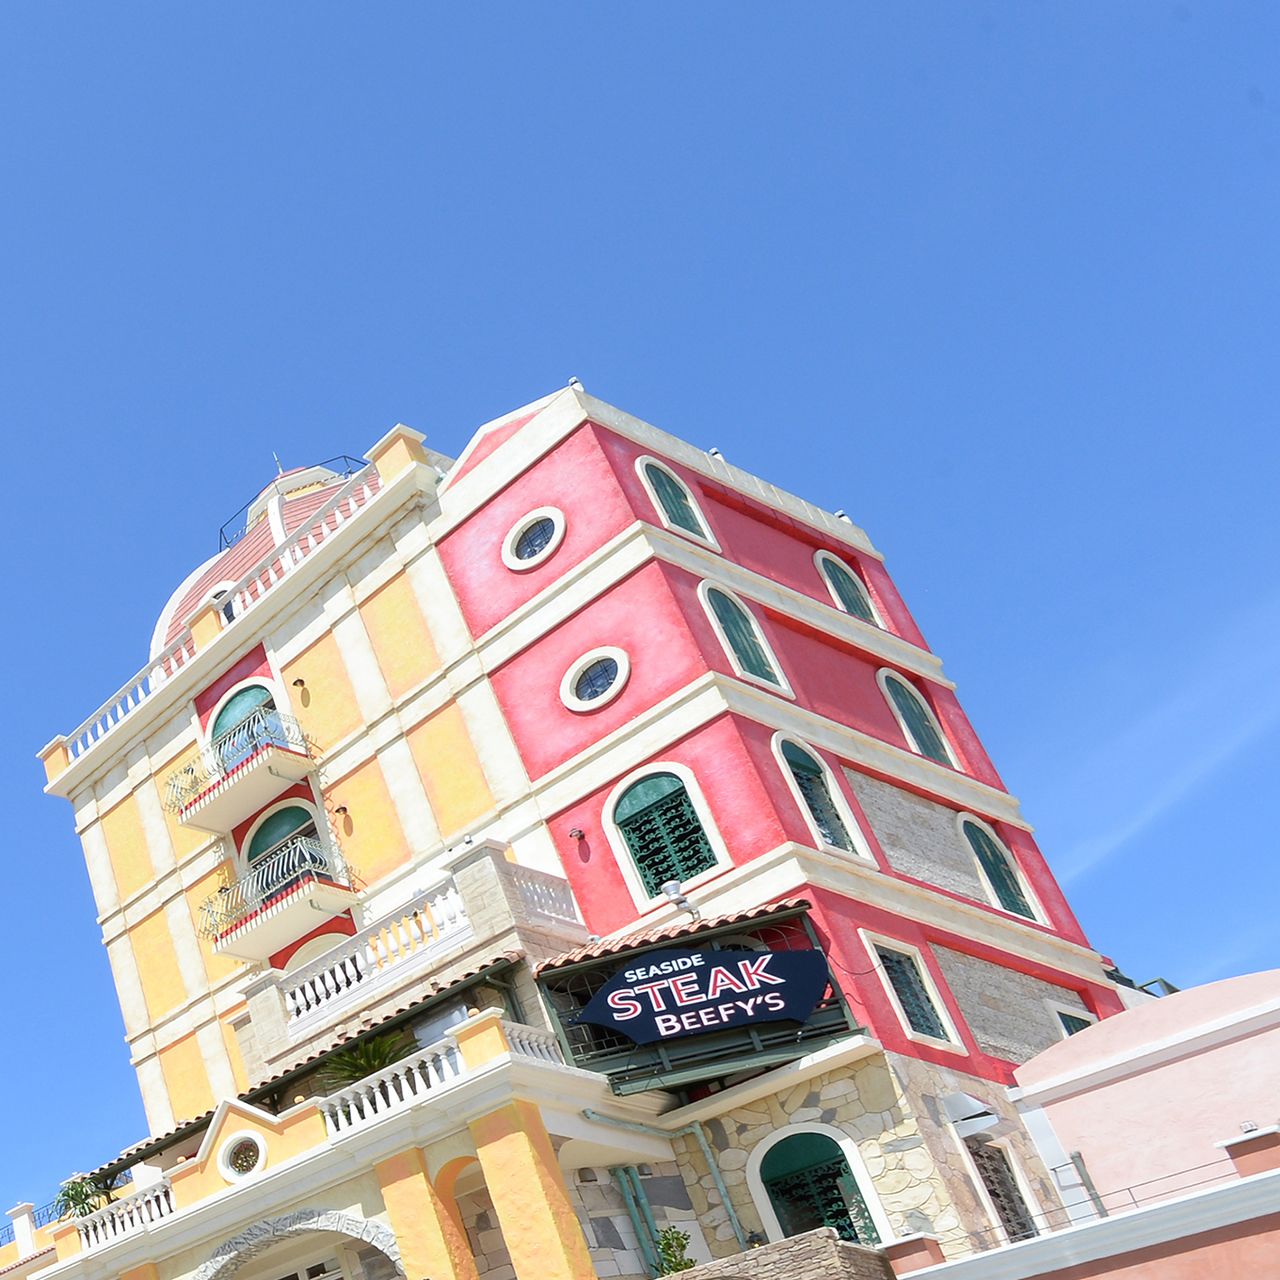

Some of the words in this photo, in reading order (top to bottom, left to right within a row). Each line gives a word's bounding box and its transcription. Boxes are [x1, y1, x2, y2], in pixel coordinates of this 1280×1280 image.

[607, 954, 785, 1021] STEAK
[624, 953, 705, 984] SEASIDE
[655, 993, 785, 1037] BEEFY'S
